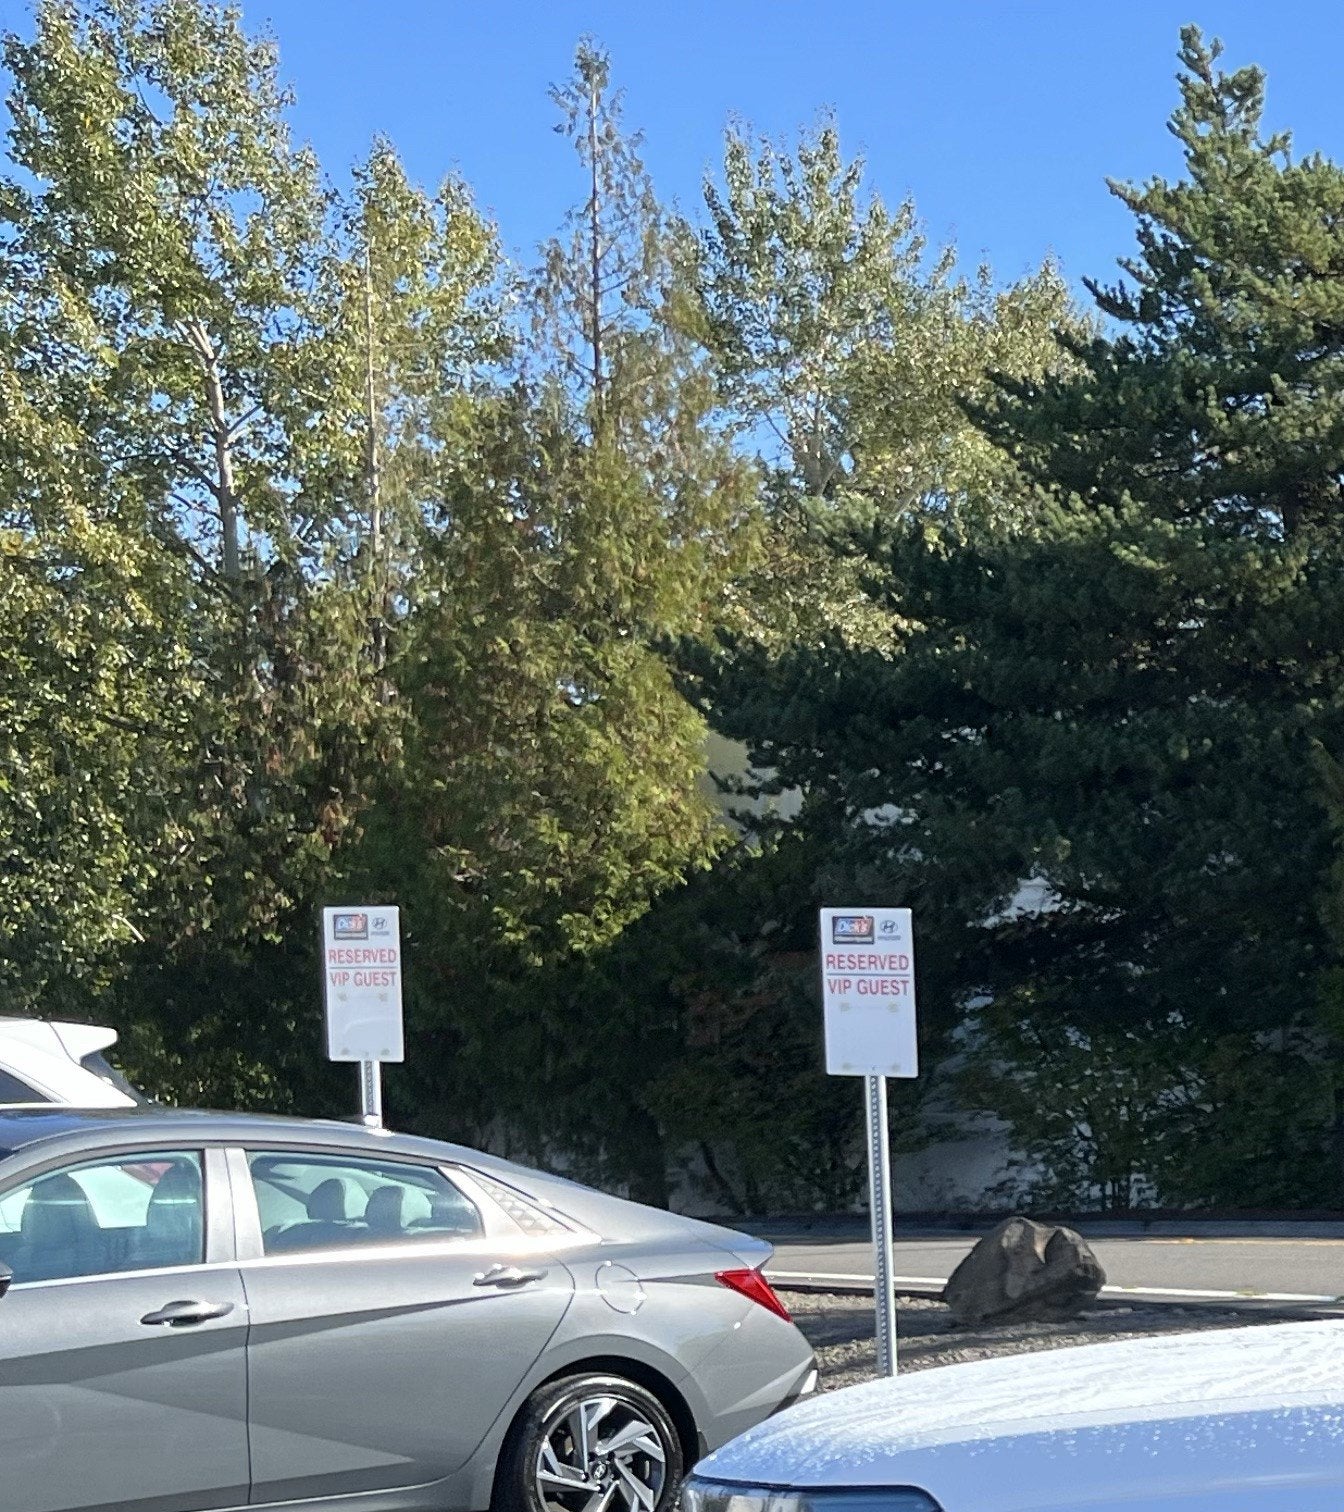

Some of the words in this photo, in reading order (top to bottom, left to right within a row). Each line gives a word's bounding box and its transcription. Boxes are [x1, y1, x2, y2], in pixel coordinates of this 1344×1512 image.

[328, 949, 397, 964] RESERVED
[826, 954, 909, 971] RESERVED
[330, 971, 350, 987] VIP
[353, 971, 397, 987] GUEST
[827, 978, 852, 995] VIP
[857, 978, 910, 995] GUEST
